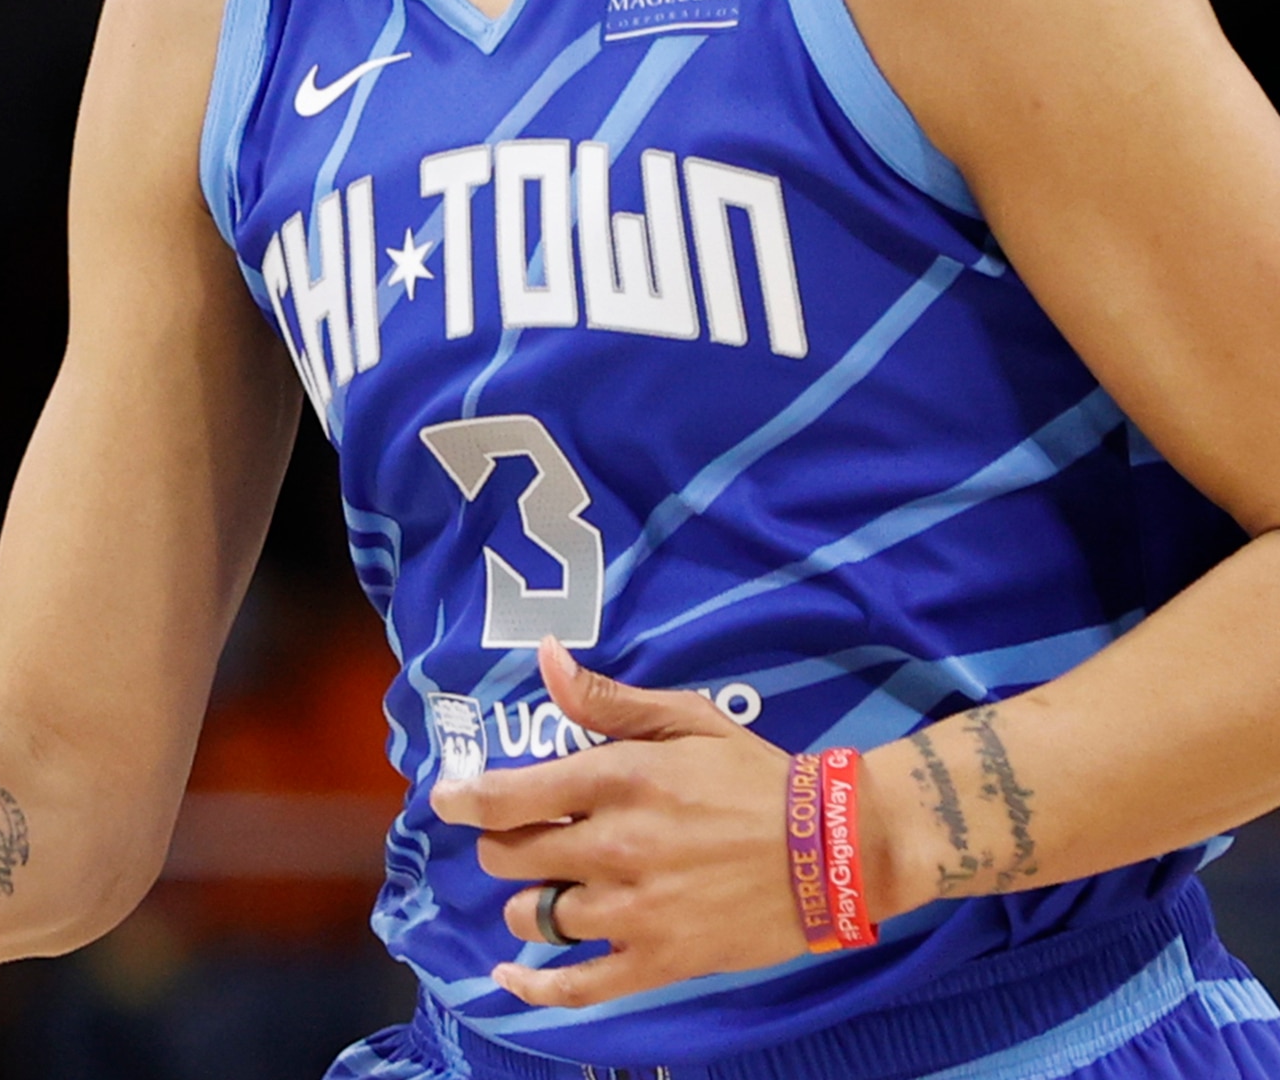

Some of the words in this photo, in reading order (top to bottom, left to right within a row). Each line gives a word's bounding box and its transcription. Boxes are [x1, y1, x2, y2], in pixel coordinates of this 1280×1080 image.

[261, 175, 381, 439] CHI
[420, 139, 809, 359] TOWN
[420, 414, 605, 649] 3
[791, 753, 820, 839] COURAG
[793, 848, 830, 927] FIERCE
